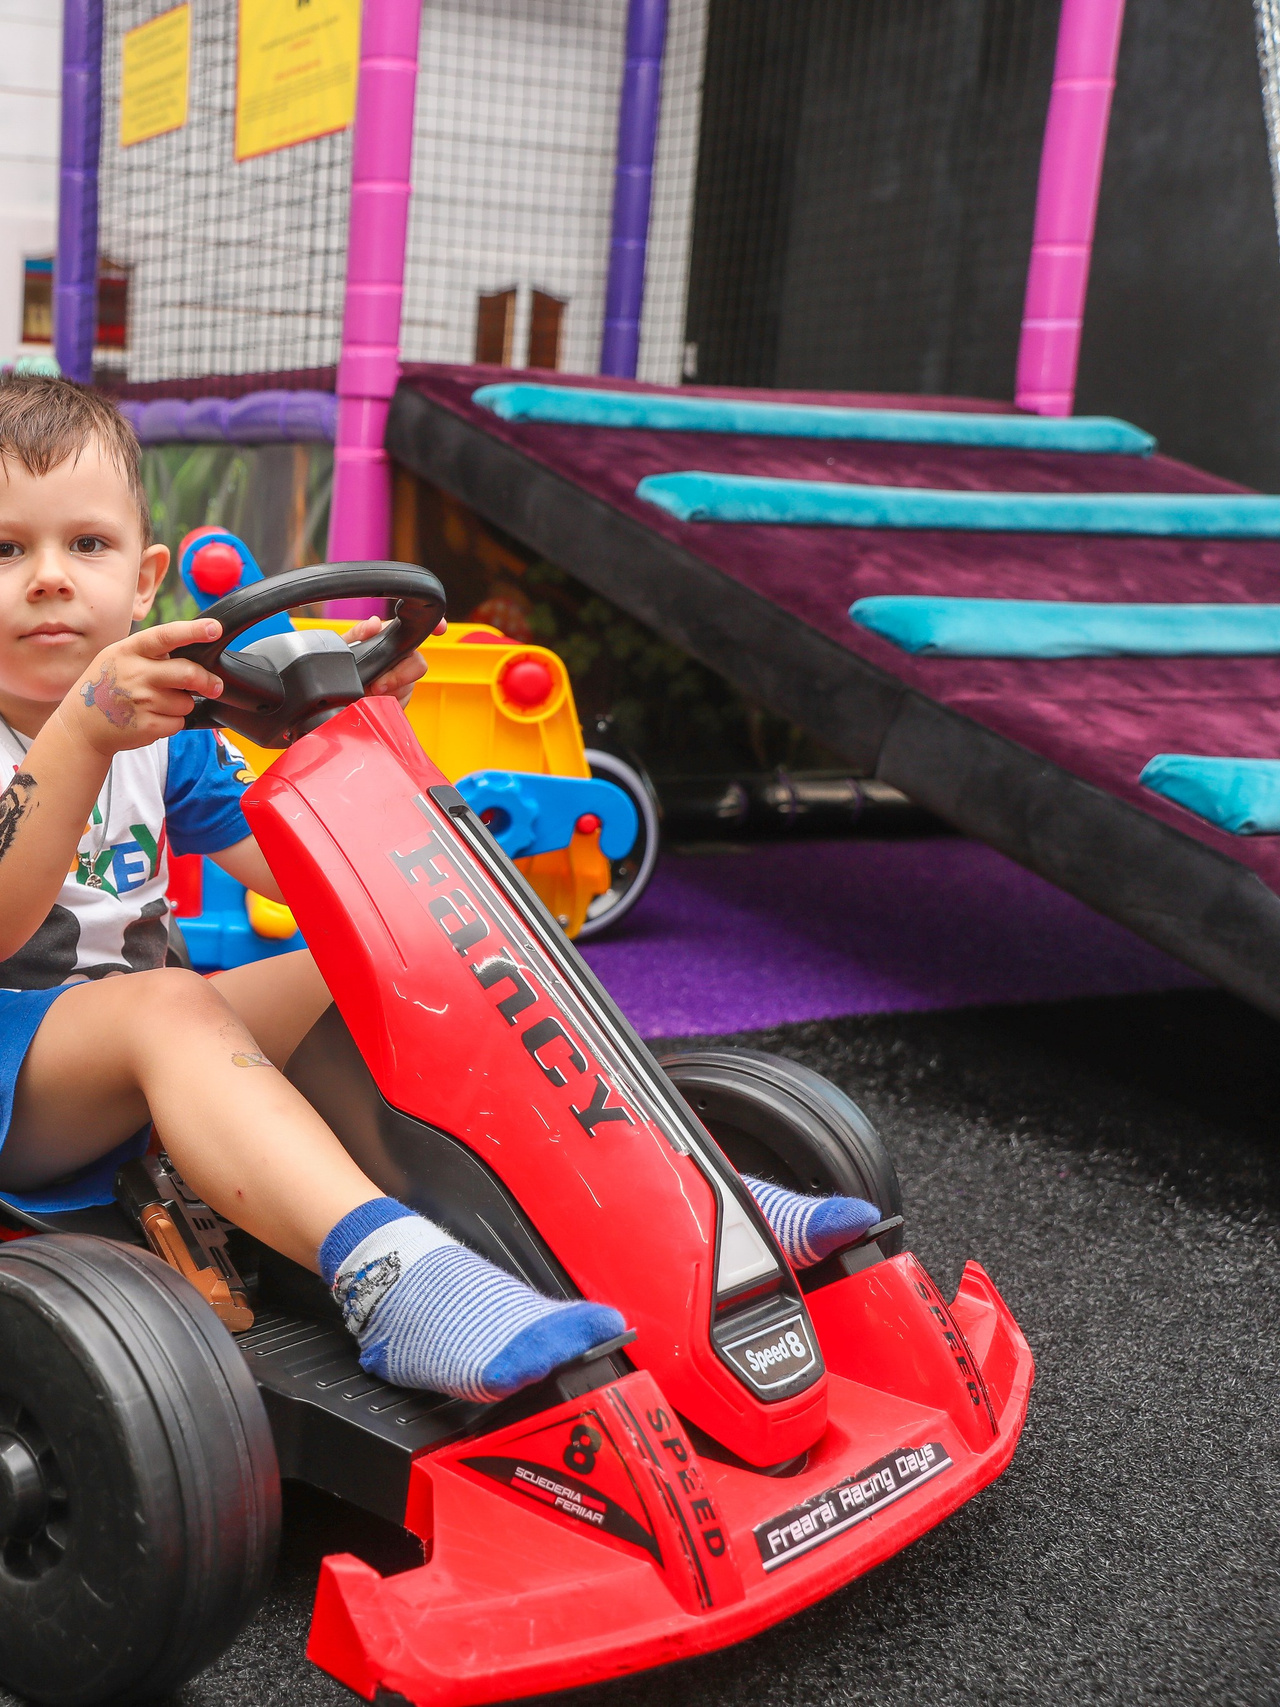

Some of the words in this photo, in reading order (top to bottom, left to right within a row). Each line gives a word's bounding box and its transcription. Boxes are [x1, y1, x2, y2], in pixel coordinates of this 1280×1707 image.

[69, 816, 166, 902] KEY
[914, 1281, 980, 1406] SPEED
[563, 1424, 602, 1475] 8
[647, 1407, 726, 1558] SPEED
[838, 1466, 896, 1512] Racing
[895, 1443, 936, 1478] Days
